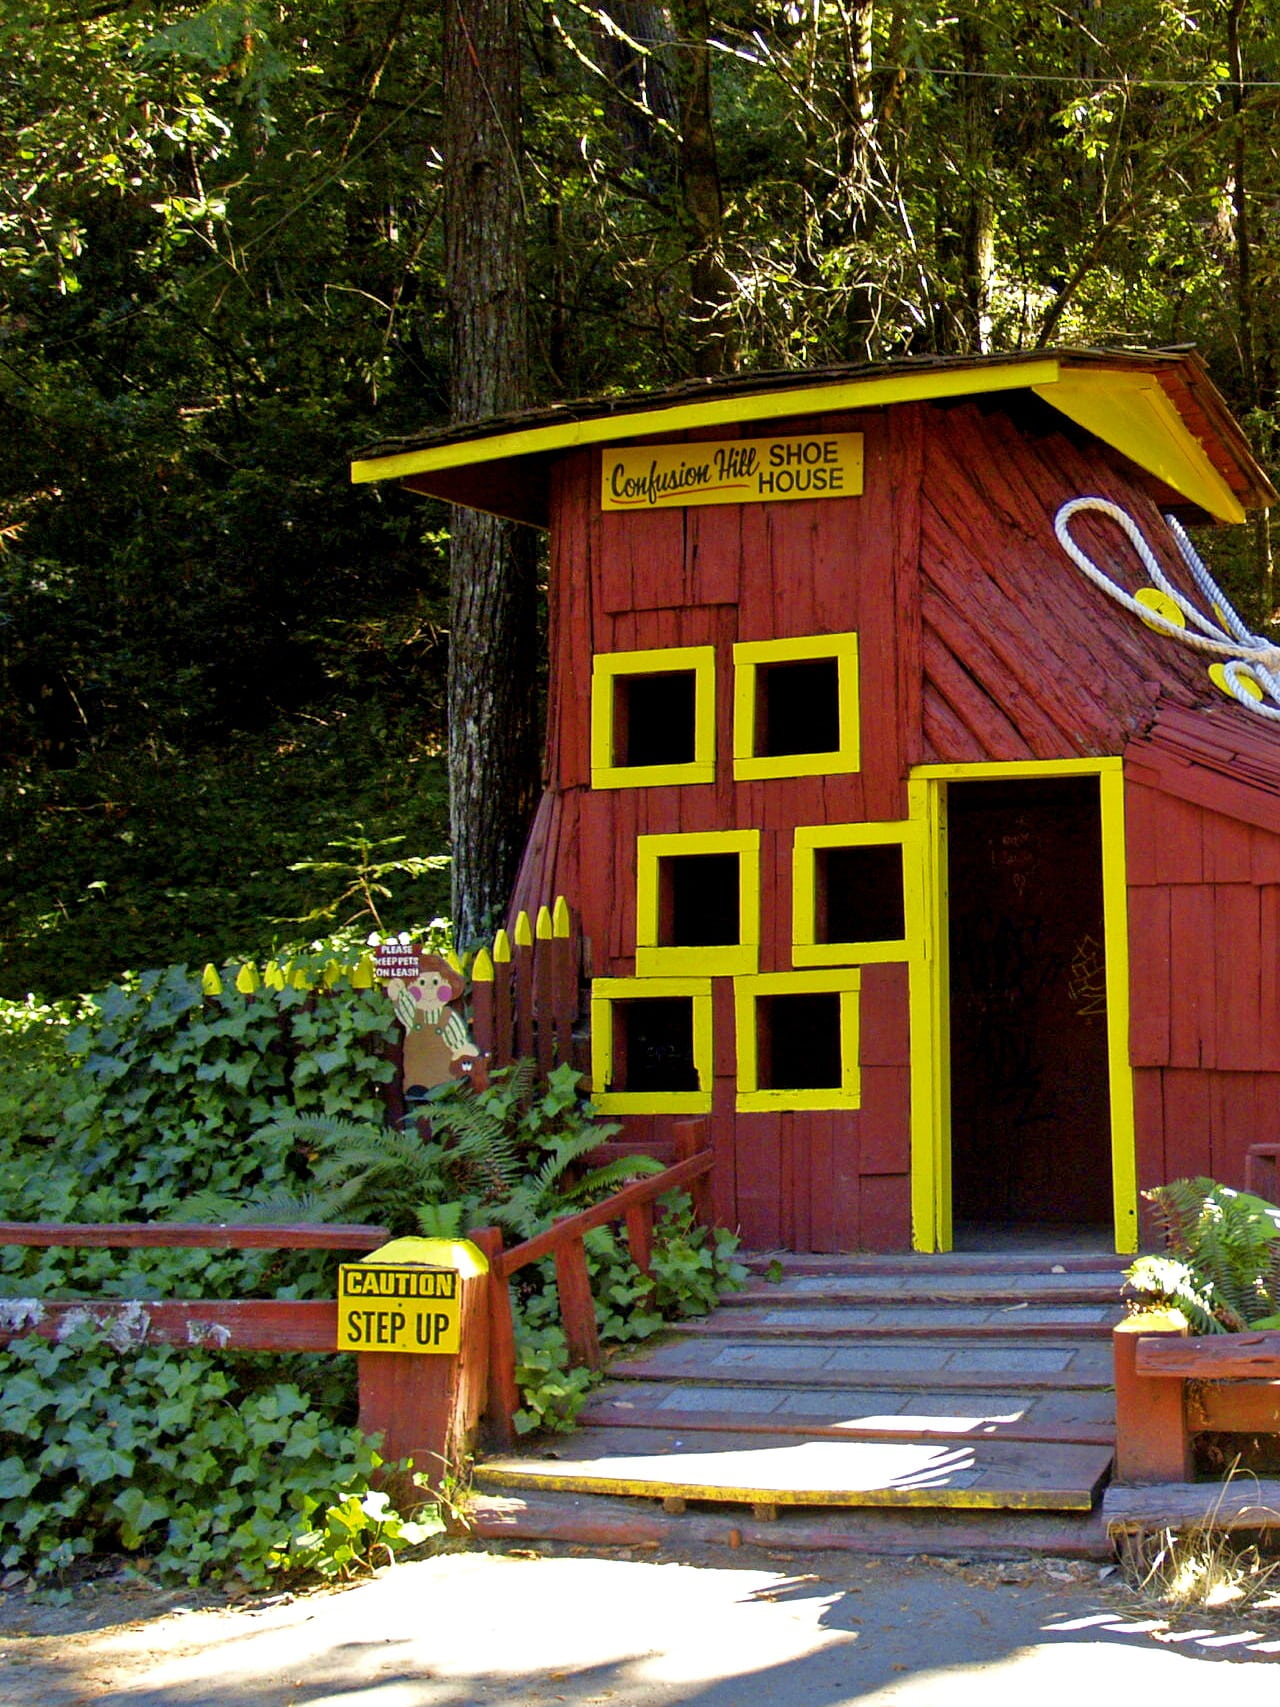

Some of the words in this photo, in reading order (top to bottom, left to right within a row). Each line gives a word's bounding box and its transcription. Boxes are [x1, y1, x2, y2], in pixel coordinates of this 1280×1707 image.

[769, 441, 838, 467] SHOE
[611, 460, 711, 504] Confusion
[714, 447, 760, 481] Hill
[758, 468, 843, 494] HOUSE
[375, 956, 397, 966] KEEP
[398, 956, 419, 966] PETS
[381, 945, 413, 955] PLEASE
[376, 967, 390, 977] ON
[391, 967, 419, 977] LEASH
[346, 1271, 452, 1296] CAUTION
[347, 1310, 405, 1344] STEP
[416, 1313, 449, 1345] UP
